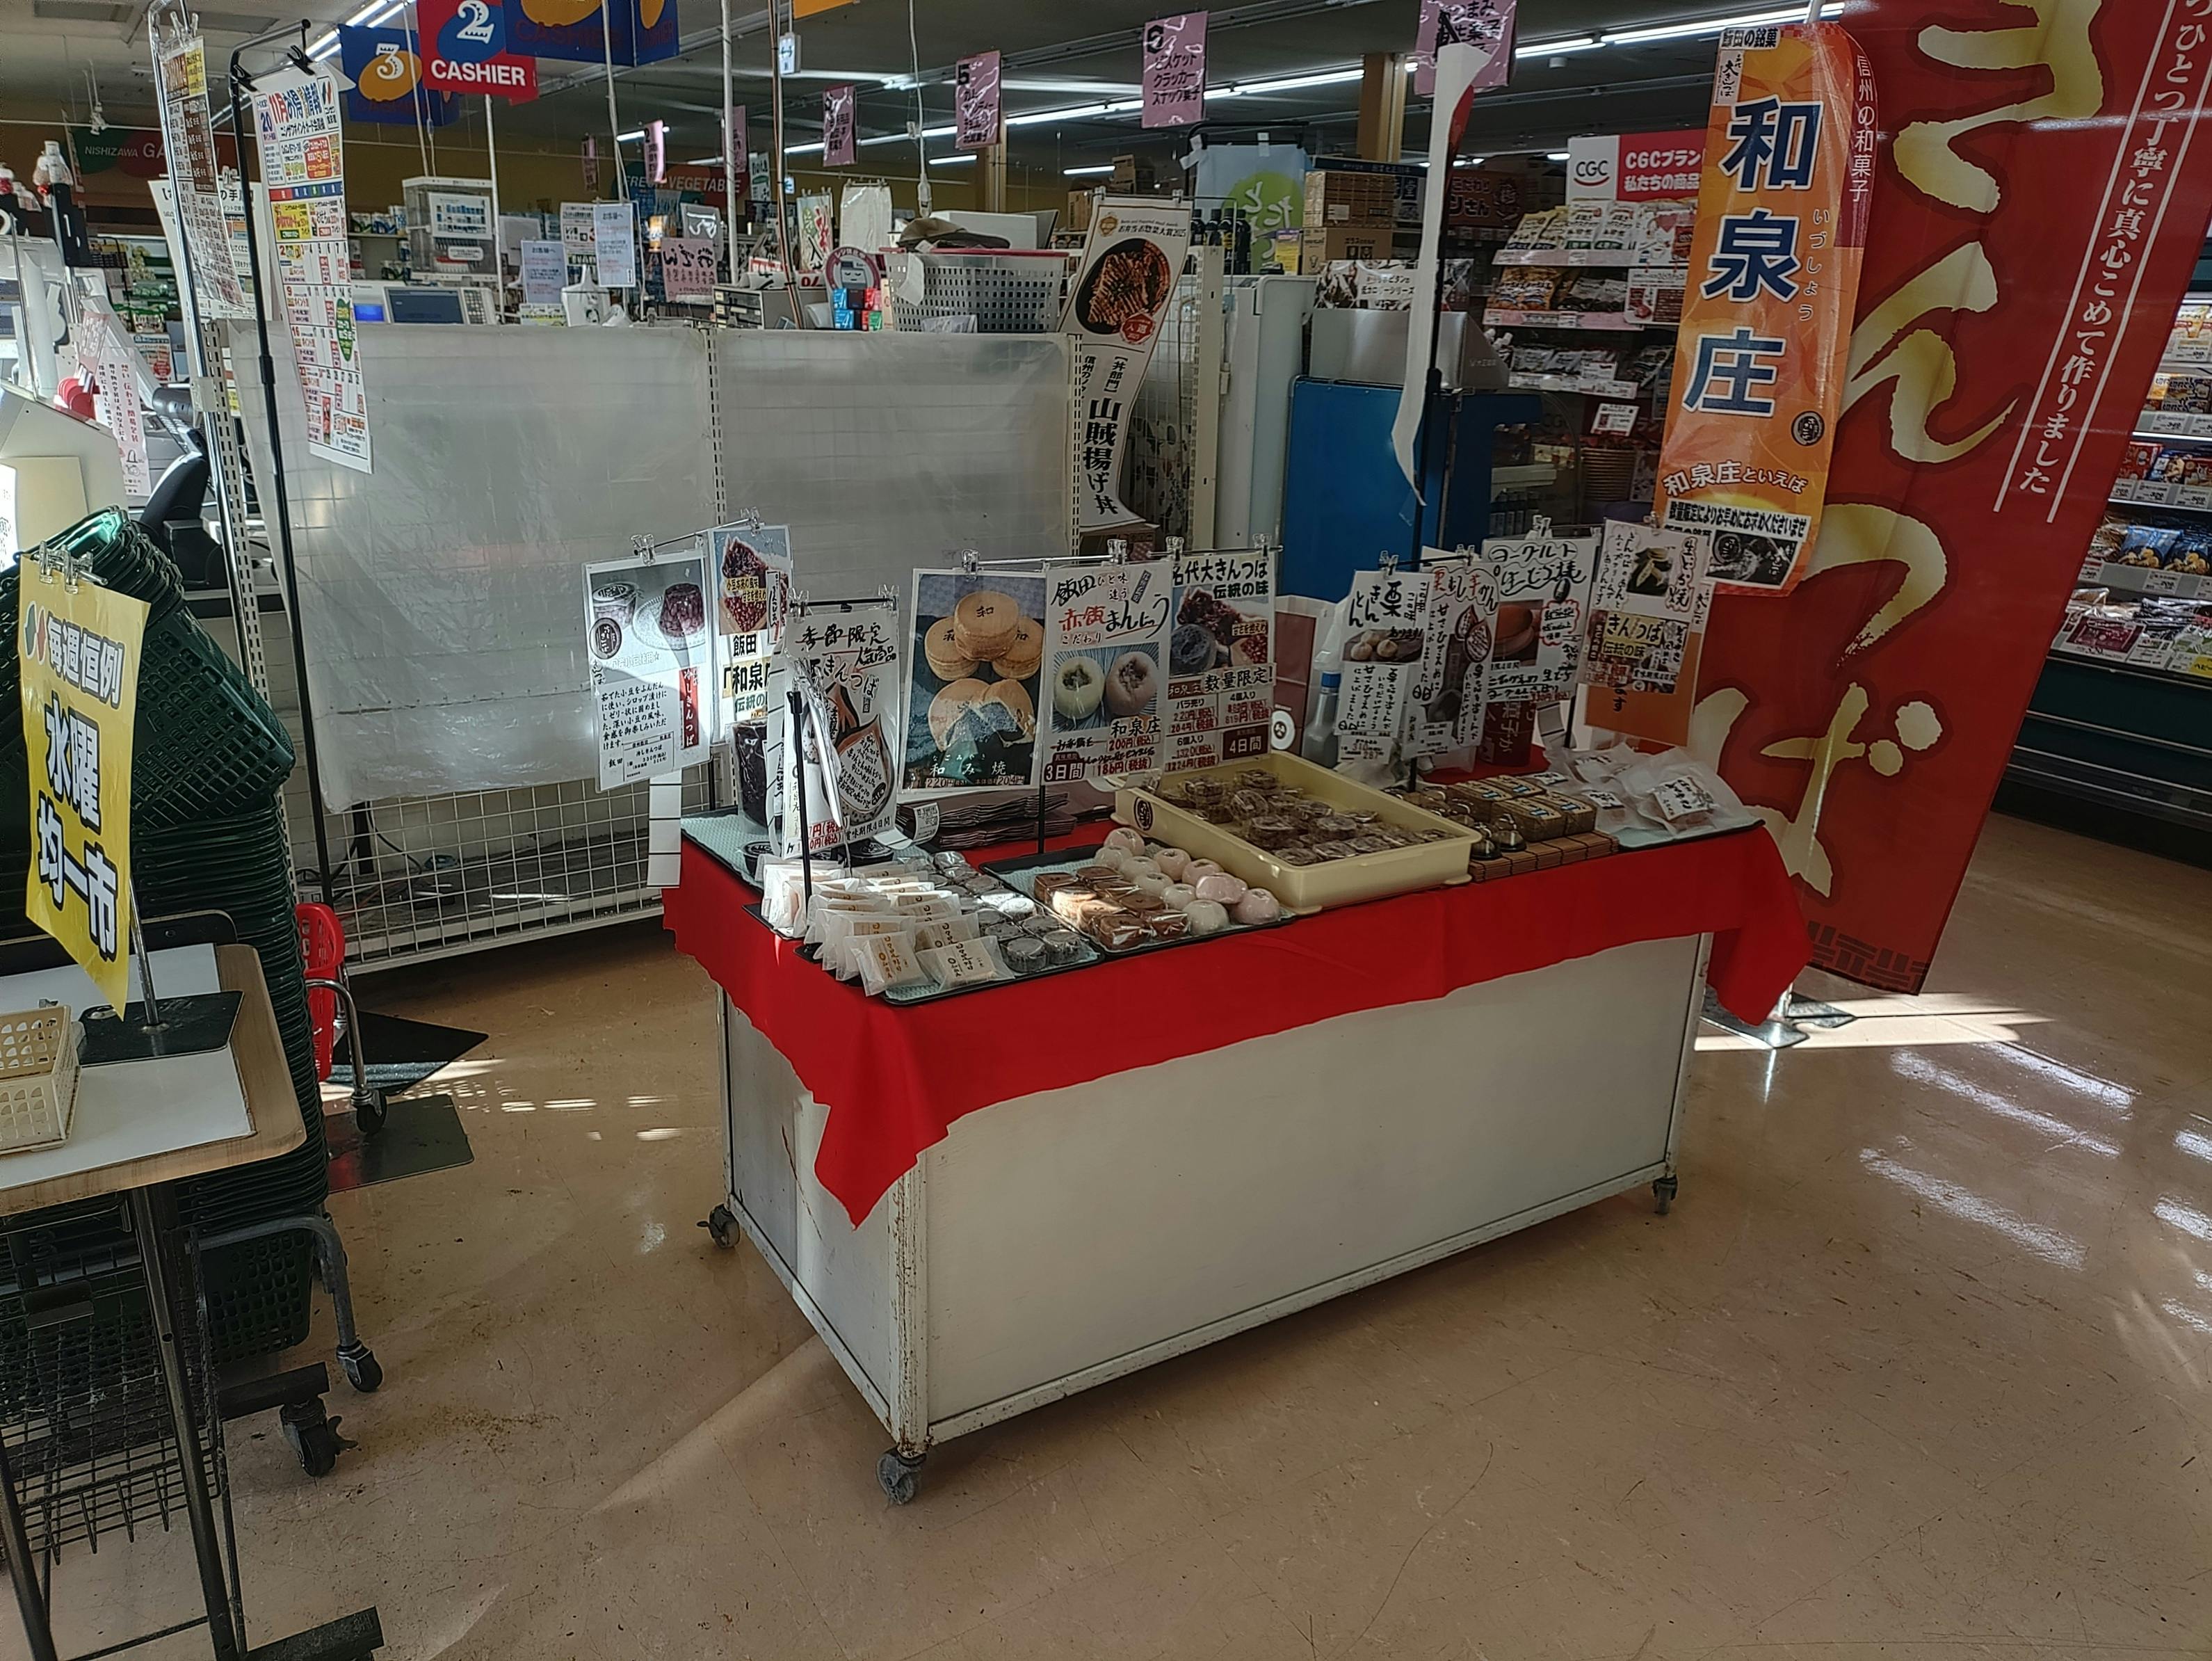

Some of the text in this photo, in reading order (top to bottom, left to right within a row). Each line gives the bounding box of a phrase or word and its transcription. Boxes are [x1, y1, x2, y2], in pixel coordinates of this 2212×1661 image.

[457, 0, 494, 44] 2
[376, 43, 404, 80] 3
[431, 59, 526, 87] CASHIER
[958, 63, 970, 85] 5
[1154, 71, 1197, 88] クラッカー
[1848, 54, 1875, 202] 信州の和菓子
[85, 145, 138, 157] NISHIZAWA
[1624, 149, 1702, 169] CGCブラン
[1576, 160, 1608, 177] CGC
[669, 175, 742, 194] VEGETABE
[1624, 172, 1700, 193] 私たちの商品
[1683, 95, 1823, 417] 和泉庄
[1798, 207, 1830, 322] いづしょう
[1083, 397, 1122, 515] 山賊揚げ丼
[1663, 460, 1809, 497] 和泉庄といえば
[1492, 544, 1577, 562] ヨーグルト
[1172, 557, 1268, 586] 名代大きんつば
[1051, 575, 1097, 607] 飯田
[1213, 580, 1269, 600] 伝統の味
[976, 605, 994, 618] 和
[1062, 632, 1102, 645] こだわり
[1607, 613, 1663, 641] きんつば
[732, 634, 757, 657] 飯田
[47, 615, 125, 710] 毎週恒例
[723, 661, 770, 694] 「和泉
[1204, 666, 1273, 693] 数量限定!
[1111, 717, 1161, 738] 和泉庄
[1229, 735, 1262, 754] 4日間
[45, 691, 102, 835] 水曜
[930, 761, 1007, 777] 和み焼
[1045, 762, 1084, 782] 3日間
[37, 790, 120, 963] 均一市
